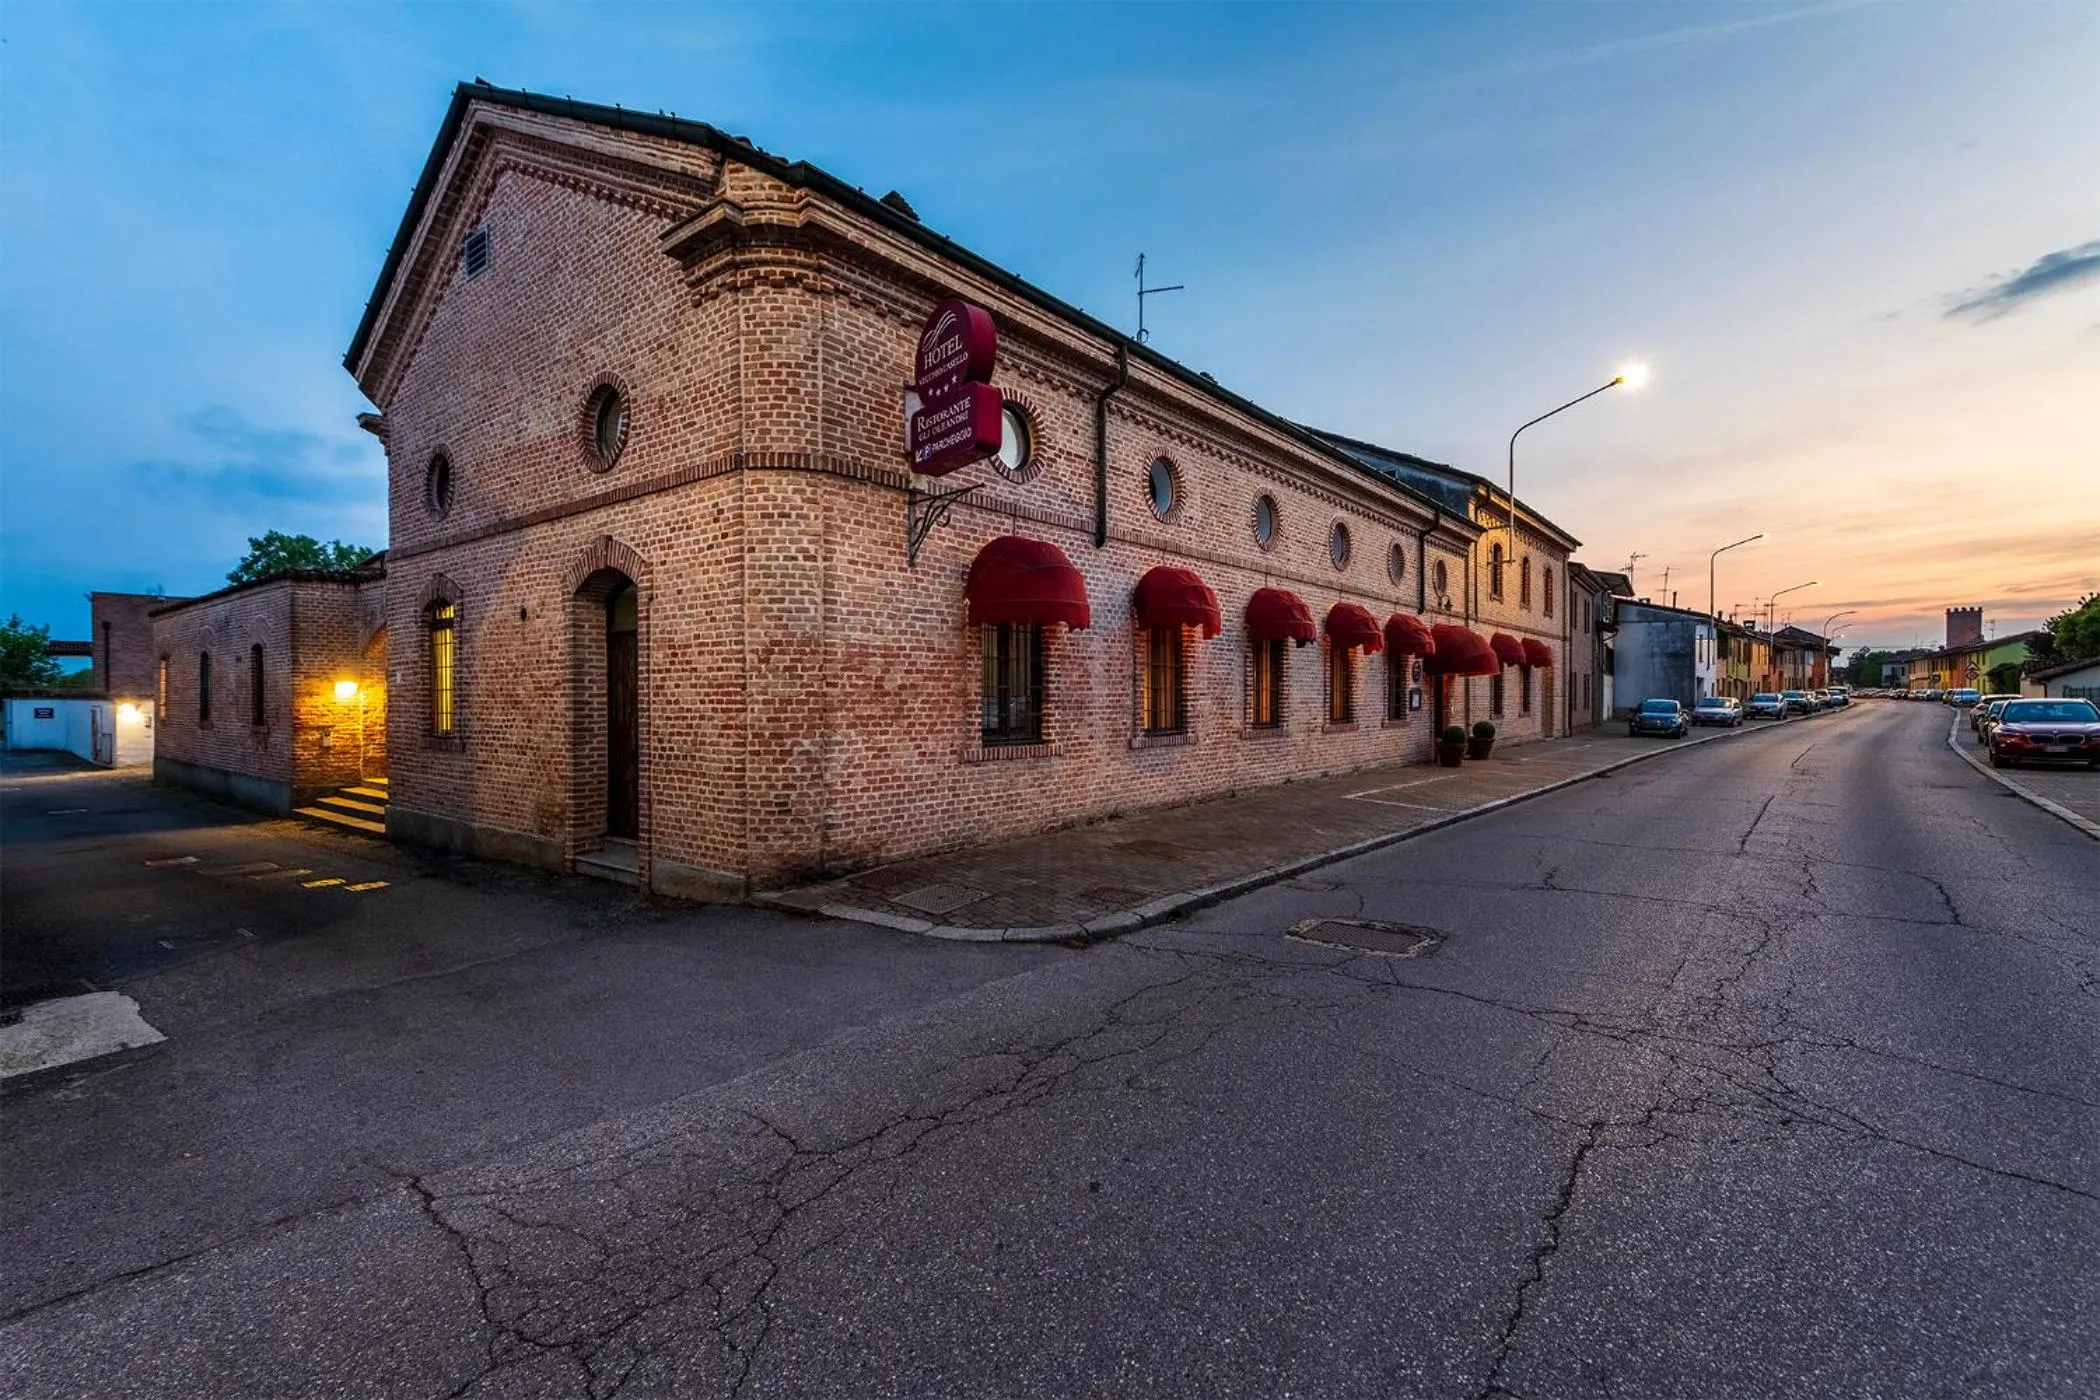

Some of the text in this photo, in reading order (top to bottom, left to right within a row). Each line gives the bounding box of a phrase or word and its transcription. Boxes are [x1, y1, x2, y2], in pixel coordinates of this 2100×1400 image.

[924, 334, 963, 370] HOTEL
[918, 410, 969, 442] GLI OLEANDRI
[932, 427, 972, 453] PARCHEGGIO
